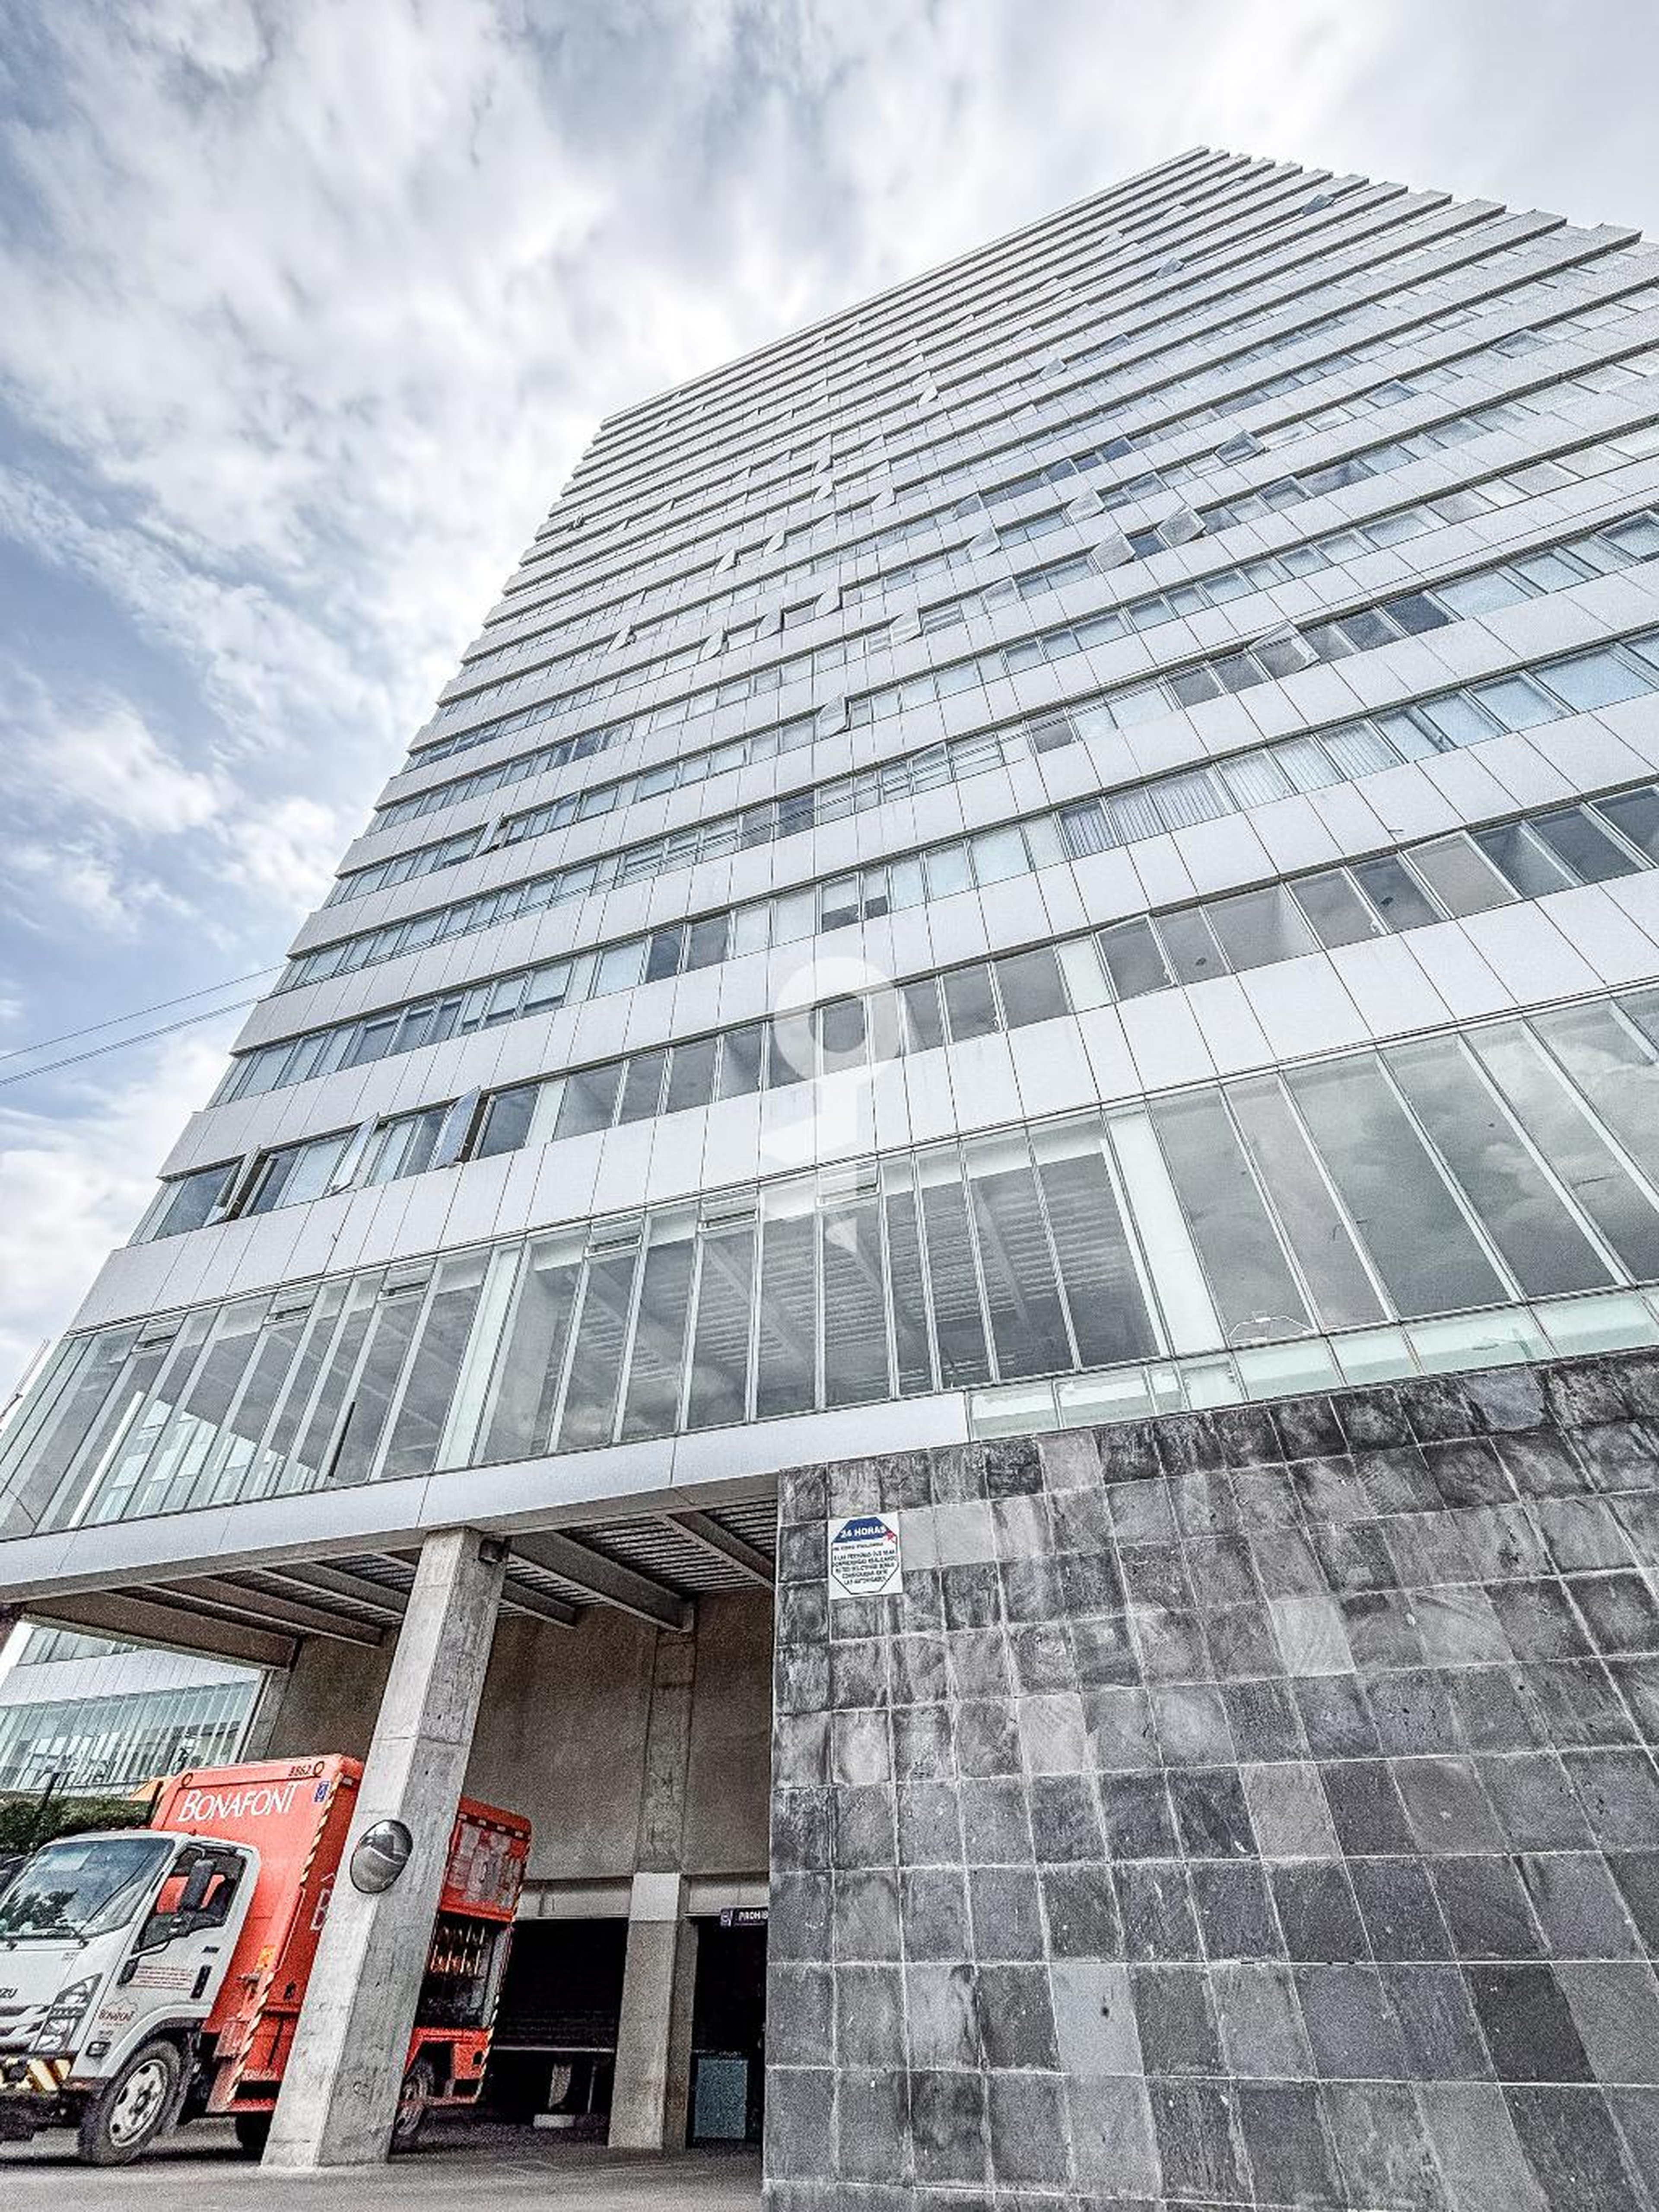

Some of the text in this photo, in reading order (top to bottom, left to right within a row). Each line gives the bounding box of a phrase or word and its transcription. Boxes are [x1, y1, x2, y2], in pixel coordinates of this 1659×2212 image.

[840, 1525, 886, 1538] 24 HORAS
[177, 1780, 304, 1822] BONAFONT
